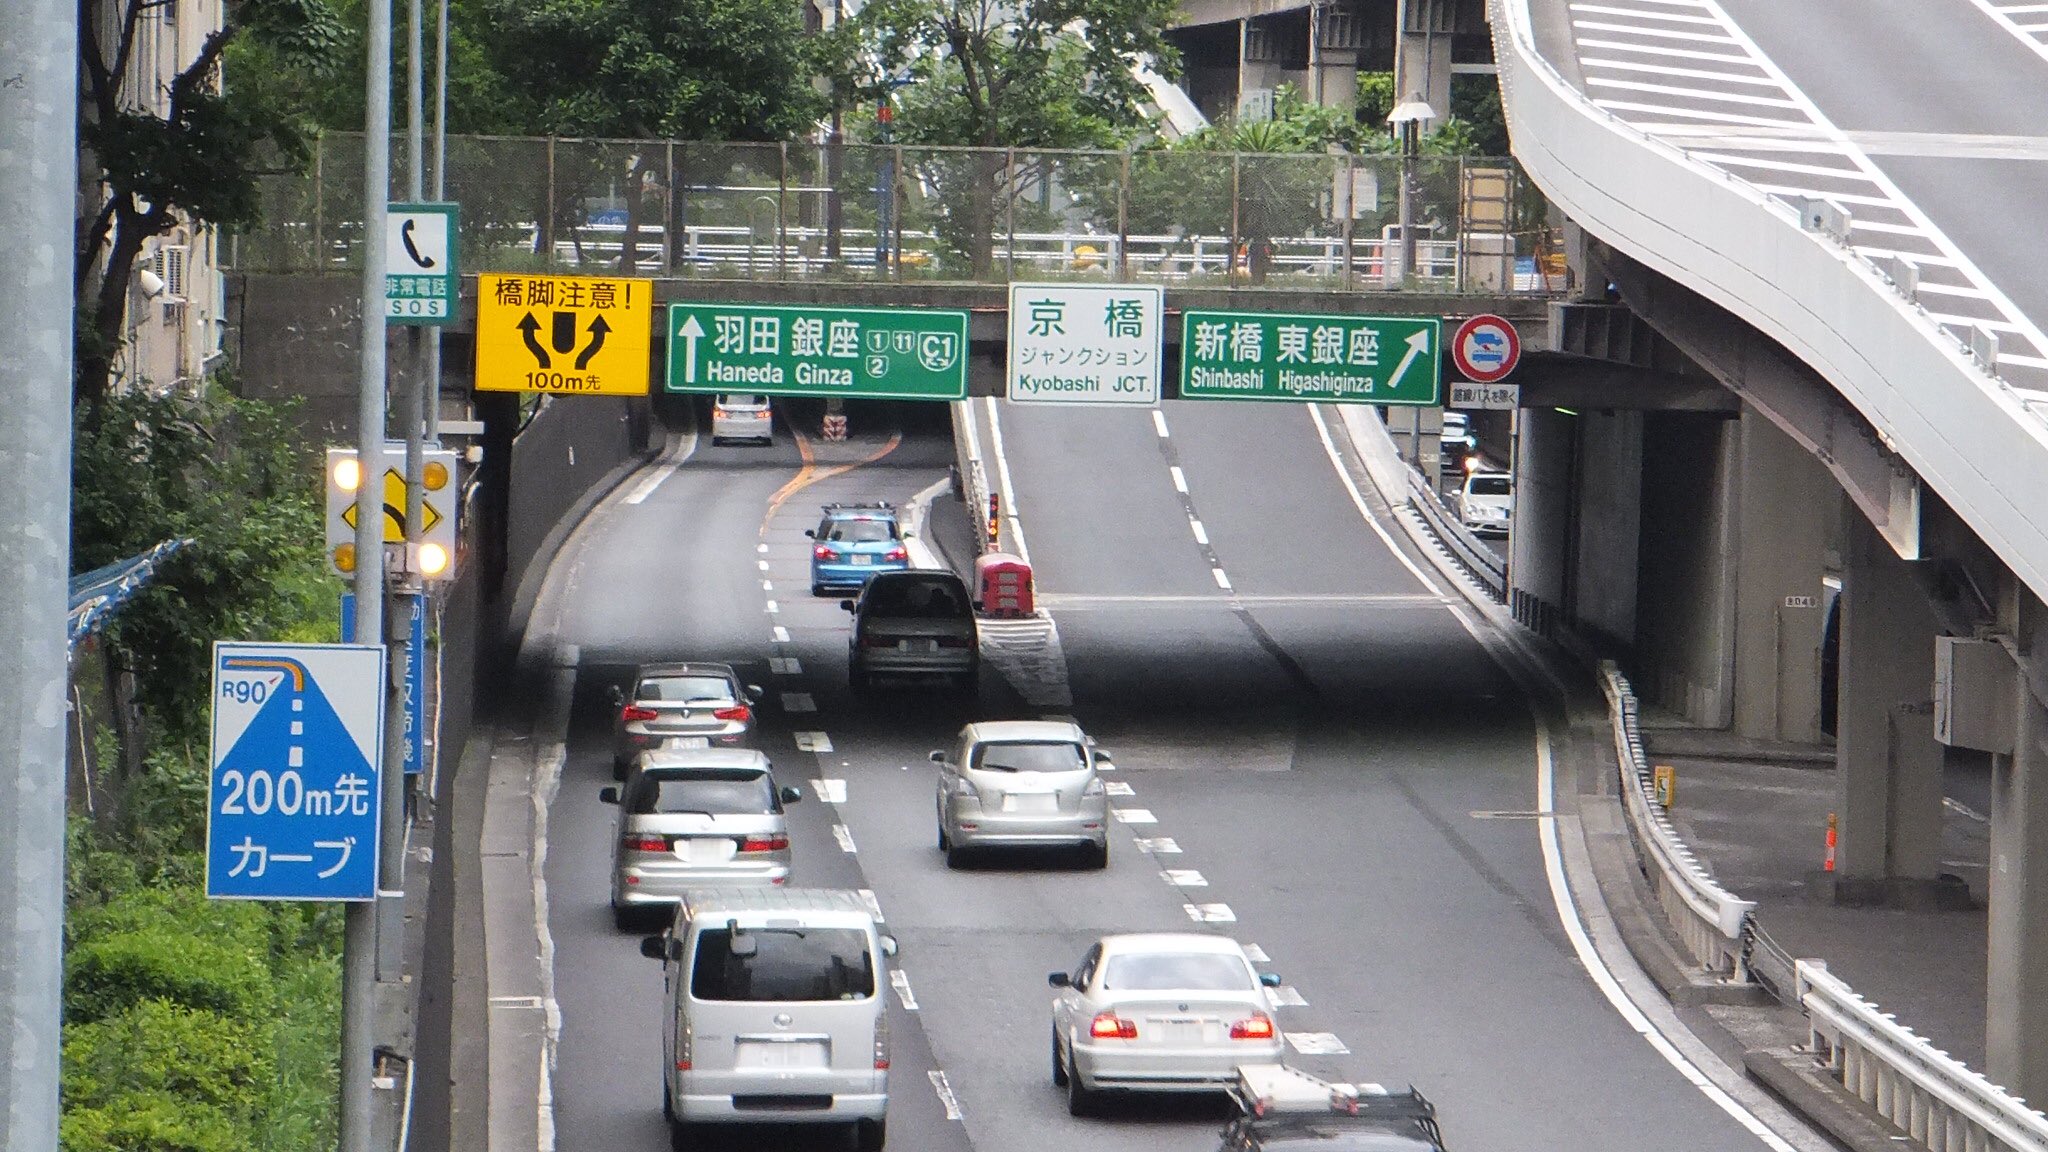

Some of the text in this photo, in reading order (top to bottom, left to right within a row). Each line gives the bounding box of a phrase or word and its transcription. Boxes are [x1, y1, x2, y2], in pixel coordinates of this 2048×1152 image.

[386, 277, 447, 297] 非常電話
[392, 300, 439, 315] SOS
[714, 315, 860, 358] 羽田 銀座
[873, 333, 912, 350] 1 11
[922, 335, 951, 358] C1
[1194, 321, 1380, 366] 新橋 東銀座
[871, 358, 883, 375] 2
[1021, 347, 1148, 366] ジャンクション
[525, 371, 601, 391] 100m先
[708, 360, 853, 386] Haneda Ginza
[1019, 374, 1151, 394] Kyobashi JCT.
[1190, 366, 1374, 396] Shinbashi Higashiginza
[222, 680, 267, 705] R90
[220, 769, 369, 817] 200m先
[228, 836, 357, 879] カーブ
